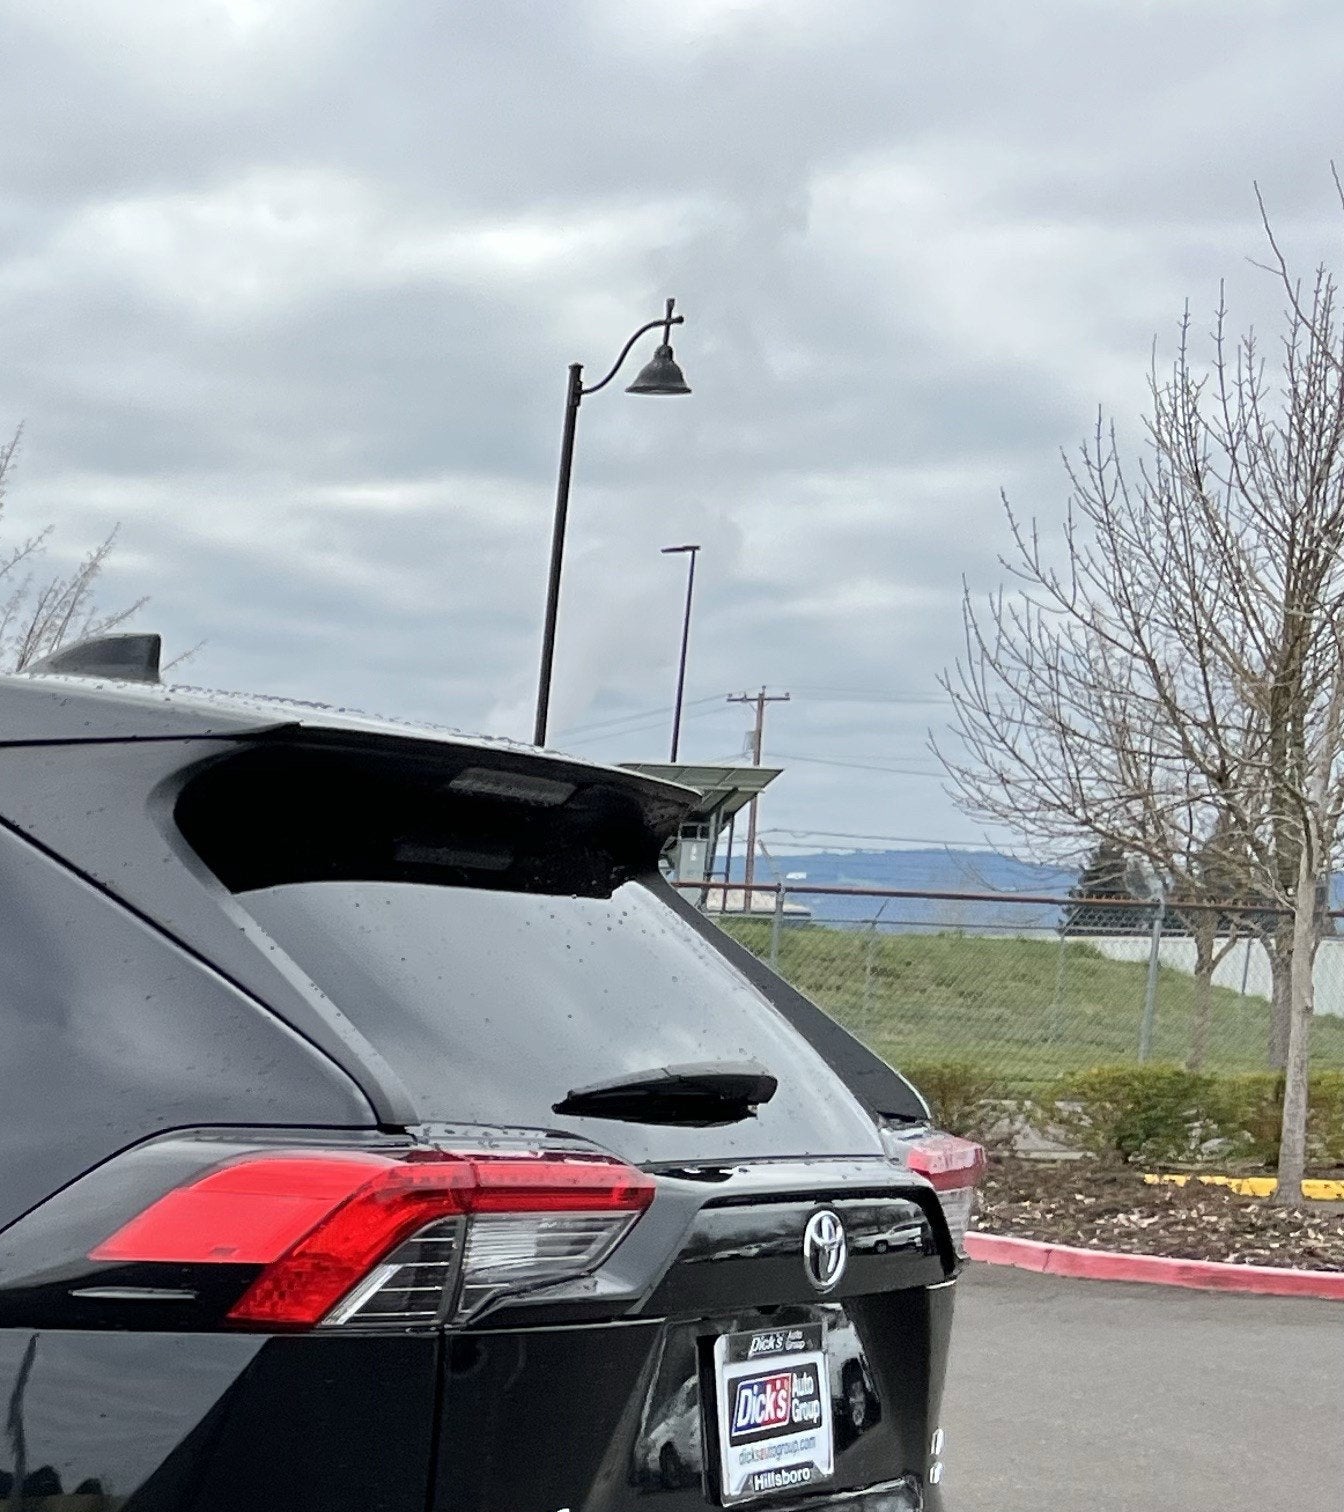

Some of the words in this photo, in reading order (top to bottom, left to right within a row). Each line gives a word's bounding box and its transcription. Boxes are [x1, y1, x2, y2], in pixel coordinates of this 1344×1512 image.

[750, 1332, 784, 1351] Dick's
[792, 1371, 814, 1398] Auto
[736, 1379, 788, 1428] Dick's
[792, 1398, 821, 1424] Group
[753, 1467, 811, 1491] Hillsboro
